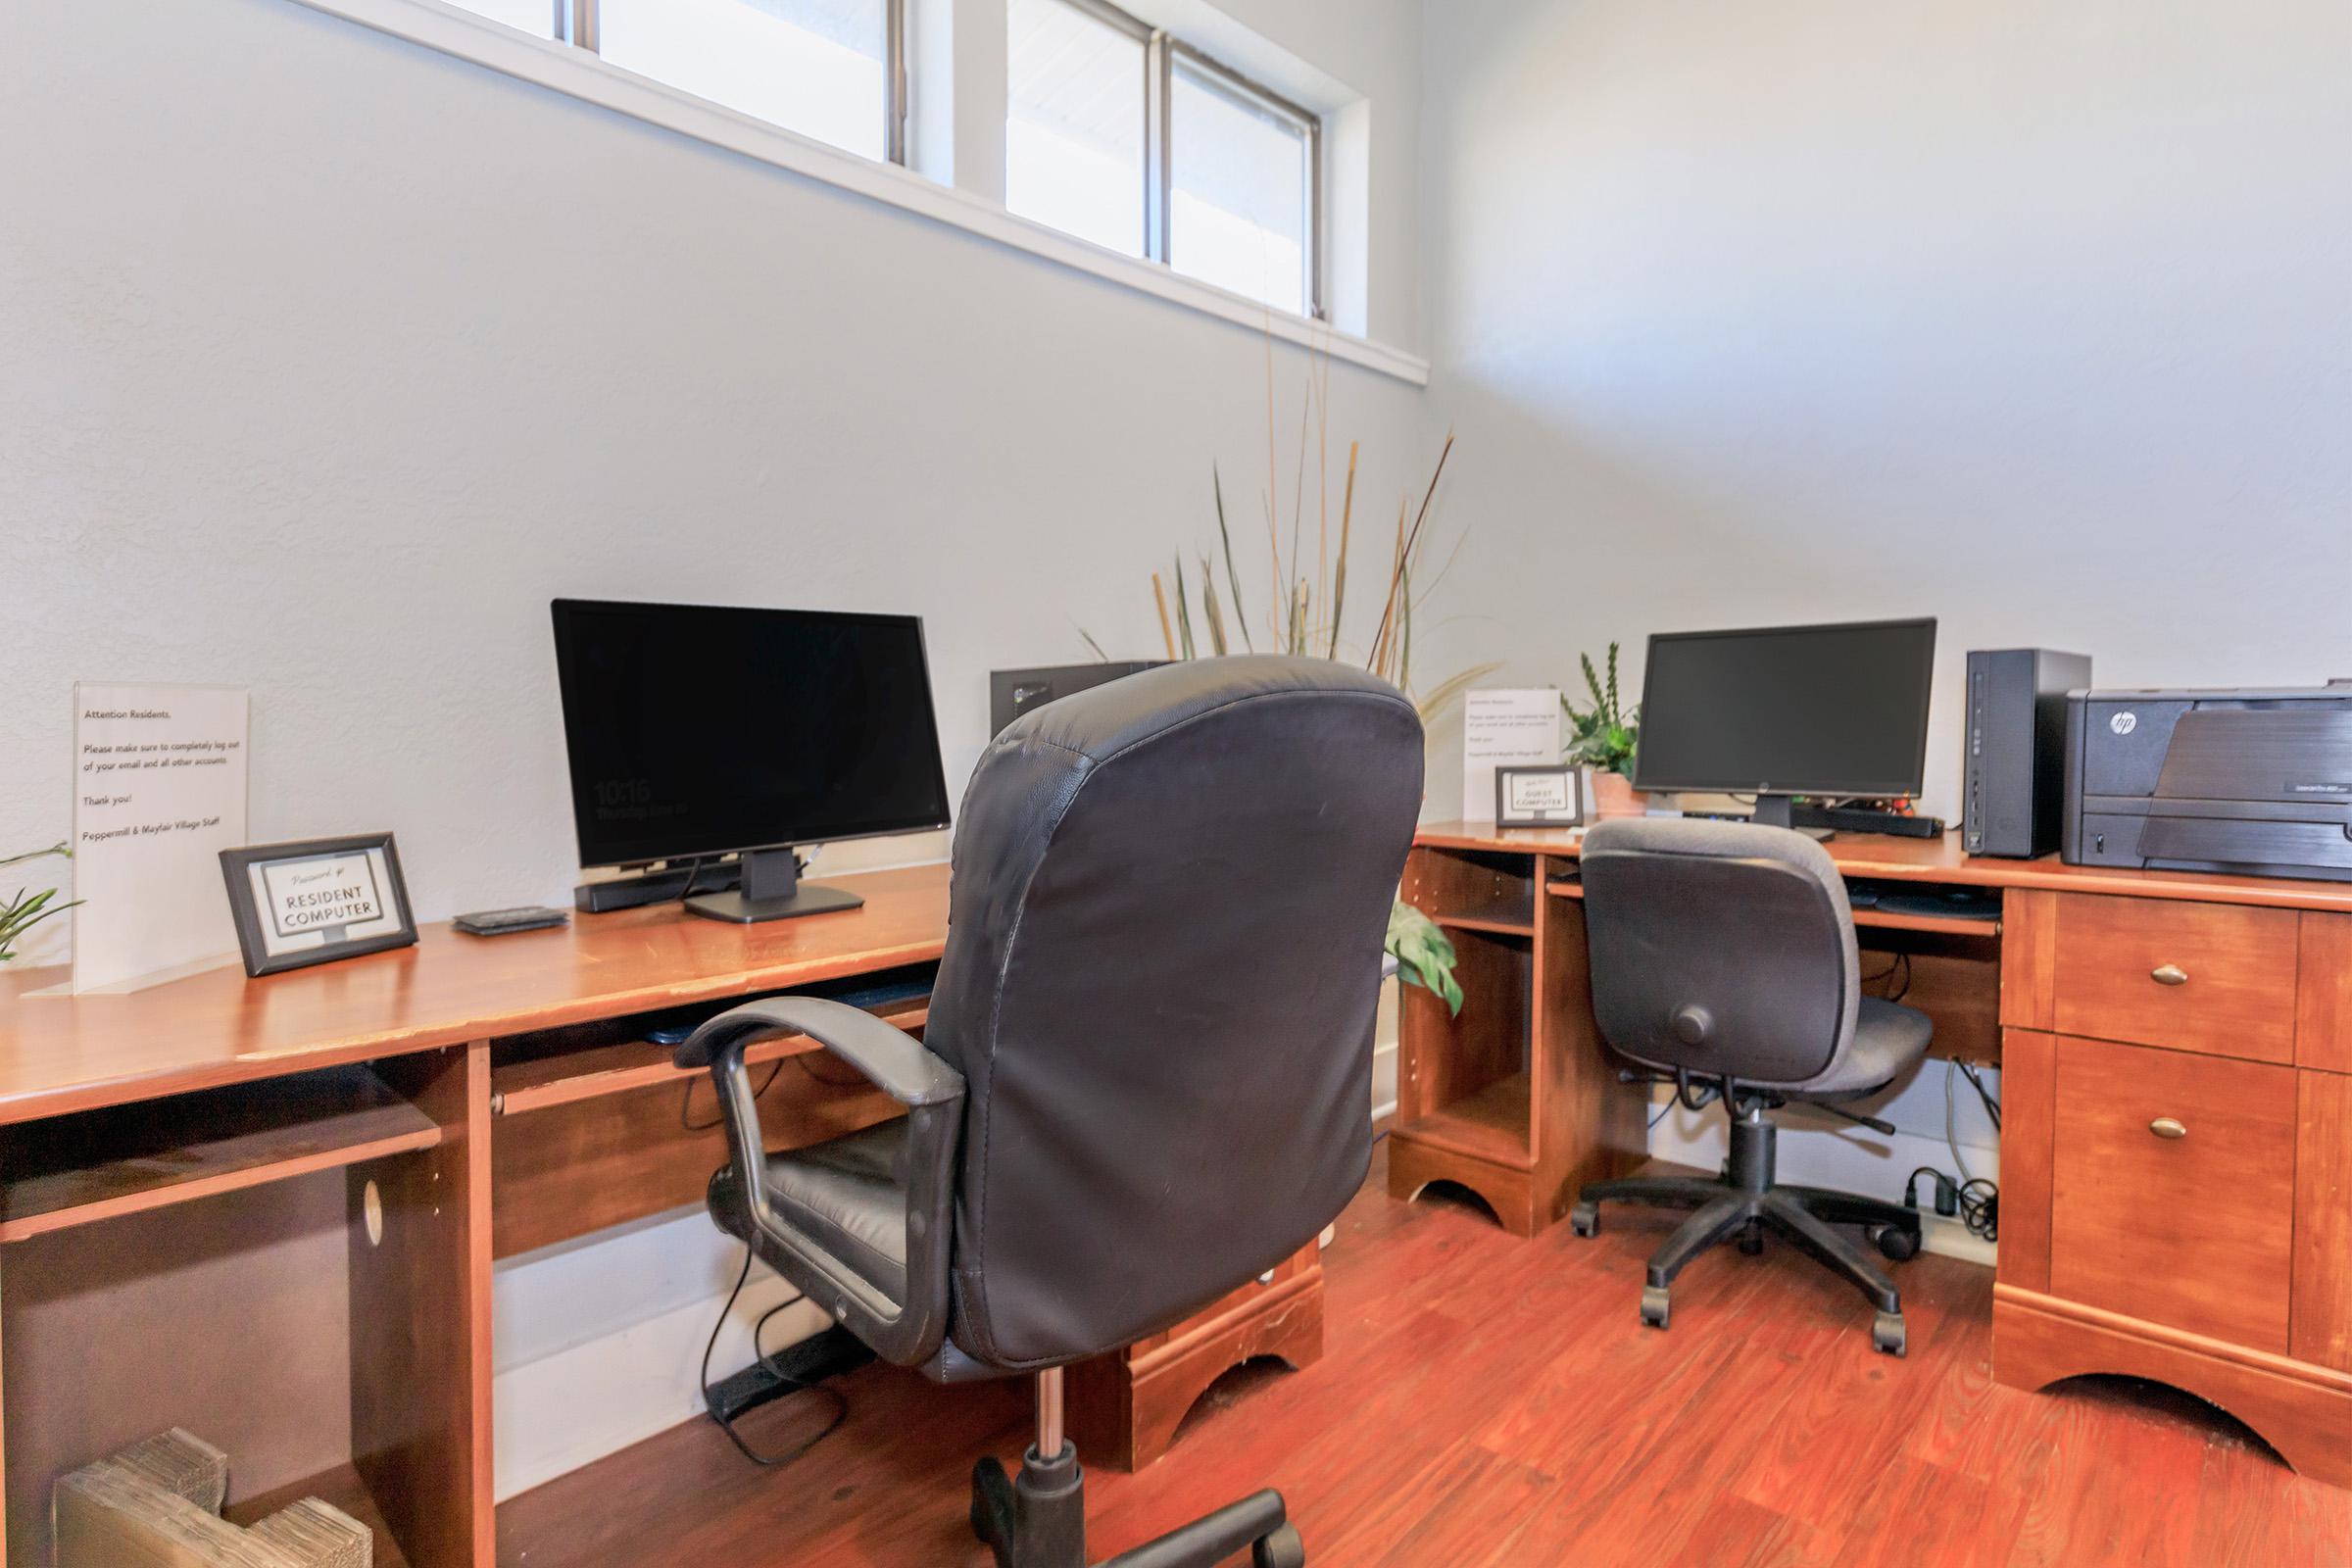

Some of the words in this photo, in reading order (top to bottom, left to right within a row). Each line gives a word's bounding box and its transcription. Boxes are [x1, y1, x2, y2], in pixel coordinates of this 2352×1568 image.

[84, 710, 127, 718] Attention
[83, 744, 112, 754] Please
[116, 743, 138, 753] make
[140, 744, 158, 753] sure
[171, 741, 213, 753] completely
[215, 741, 226, 752] log
[227, 741, 239, 750] out
[83, 760, 93, 771] of
[96, 763, 116, 774] your
[119, 759, 141, 769] email
[143, 760, 158, 768] and
[161, 758, 170, 767] all
[172, 758, 192, 767] other
[83, 795, 110, 806] Thank
[82, 826, 130, 842] Peppermill
[132, 826, 138, 835] &
[142, 822, 172, 835] Mayfair
[174, 819, 200, 831] Village
[203, 815, 220, 827] Staff
[286, 886, 362, 908] RESIDENT
[284, 902, 372, 926] COMPUTER
